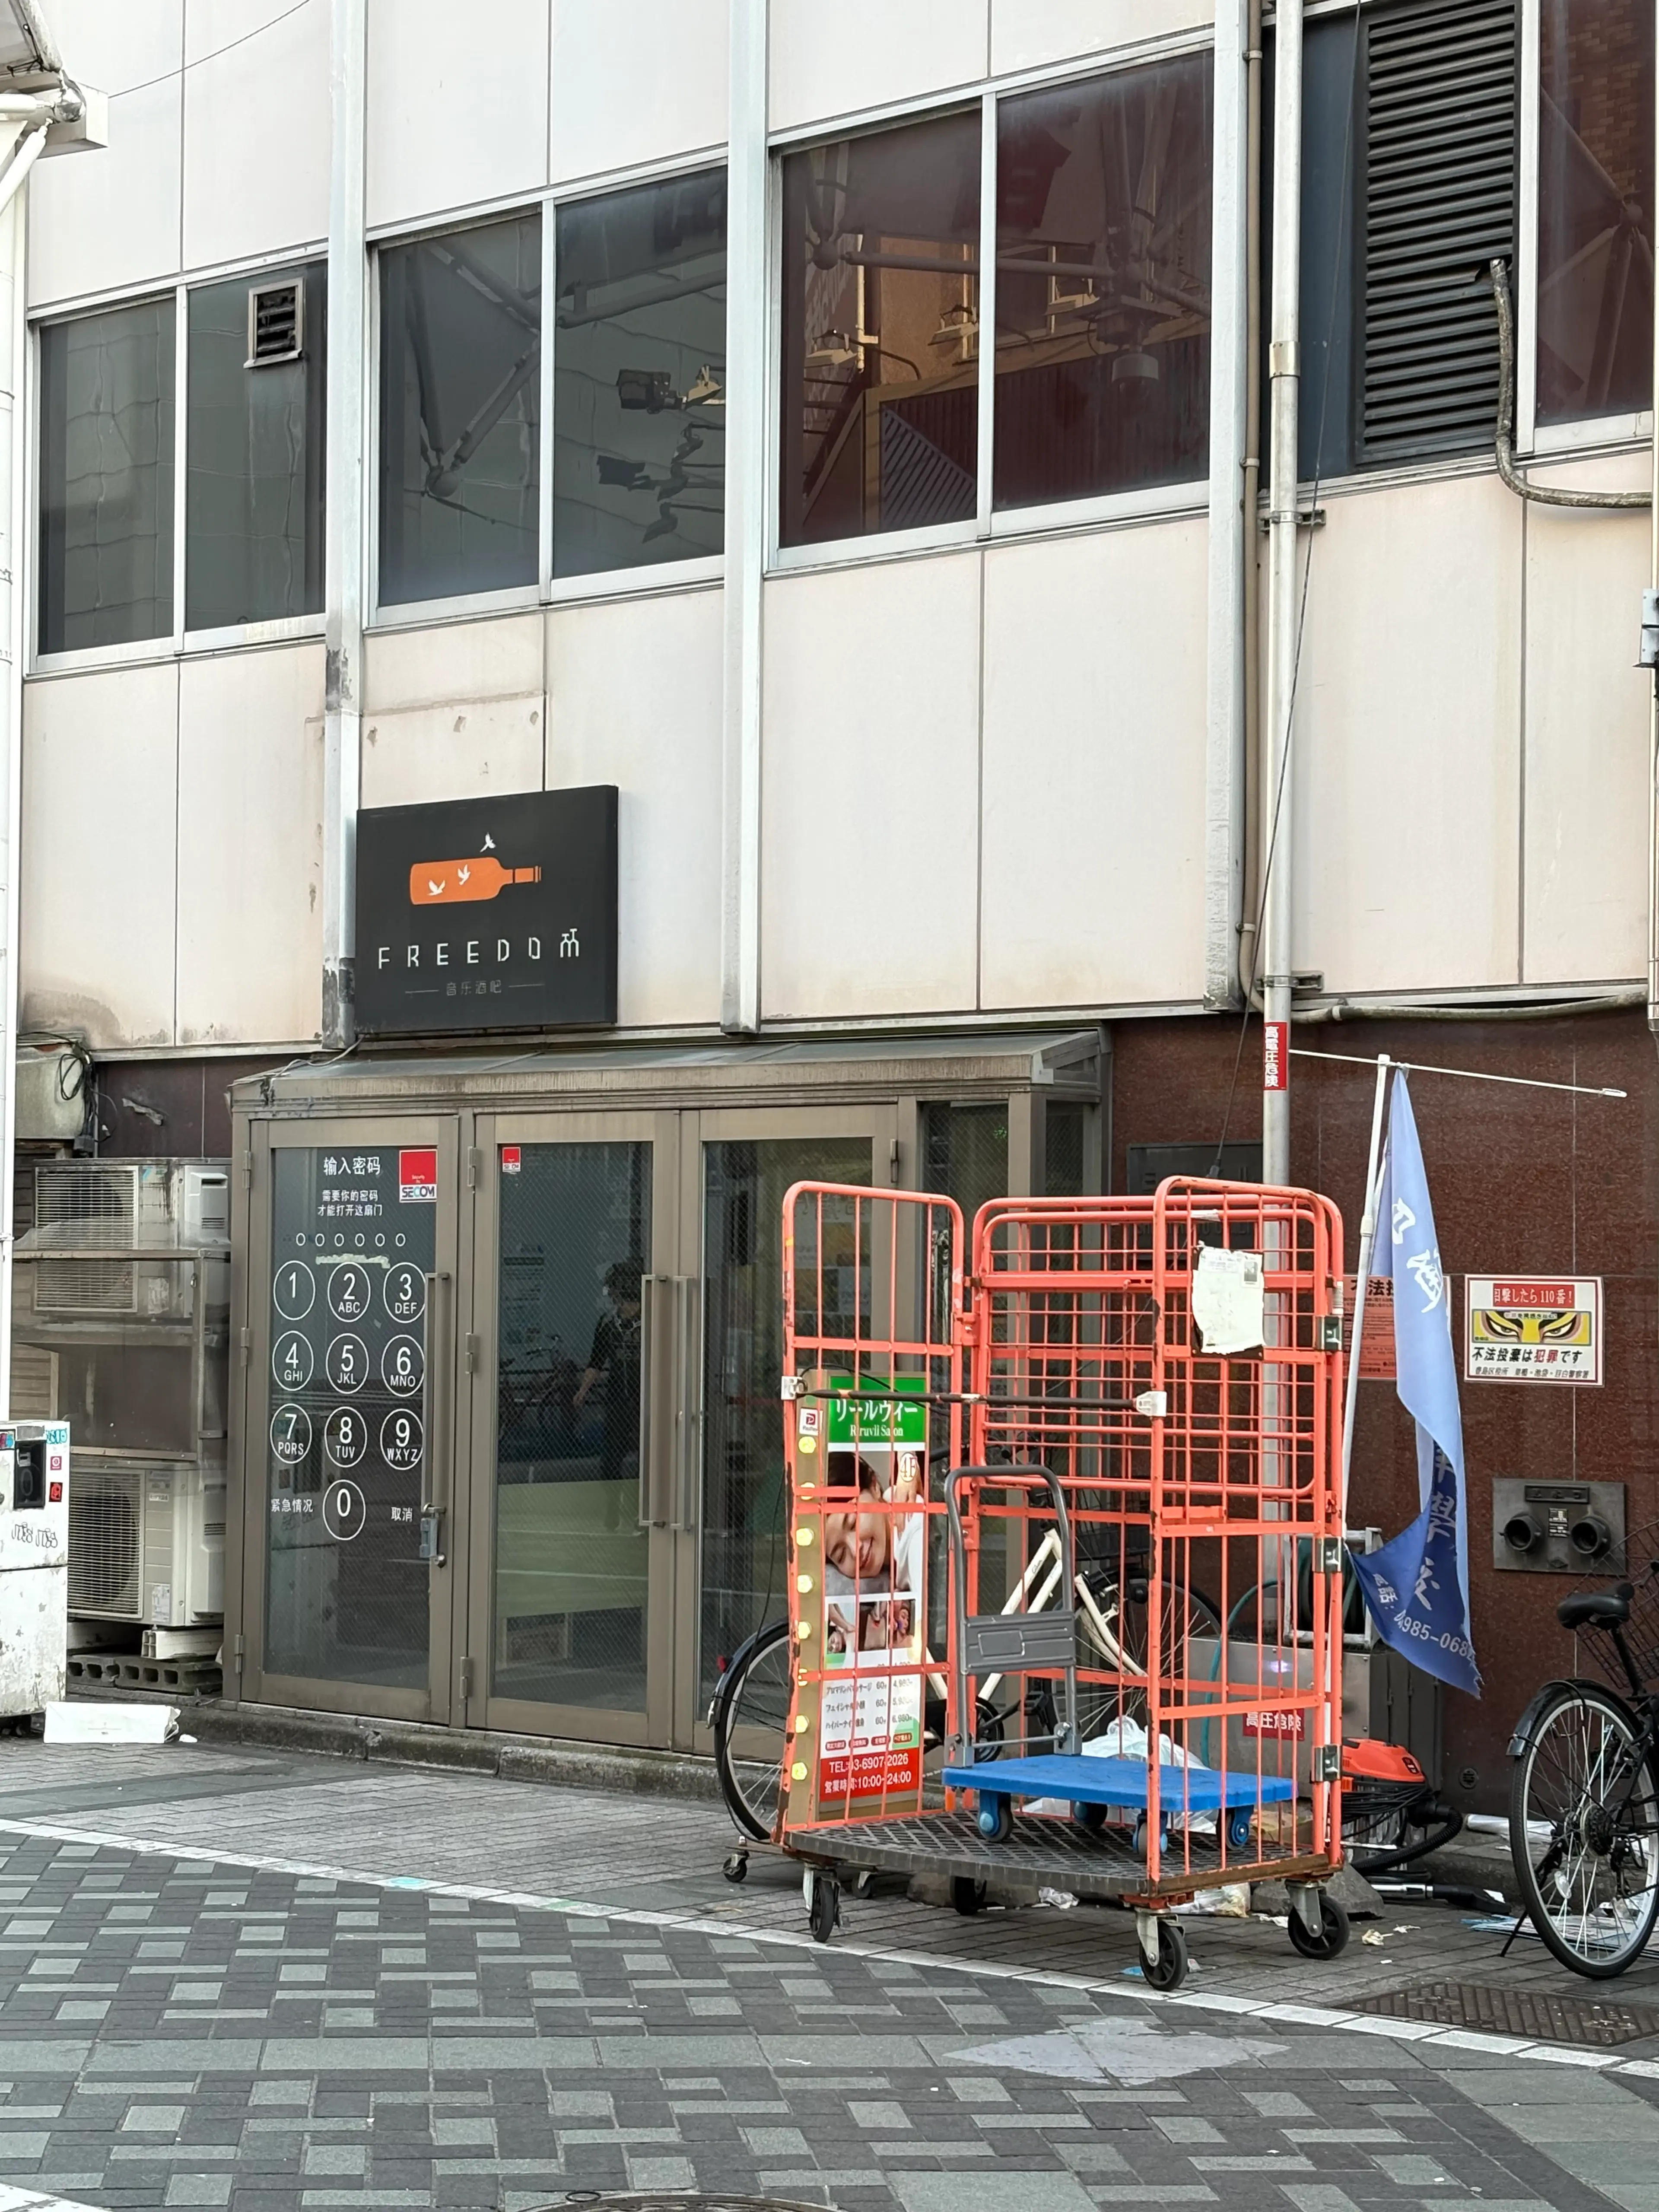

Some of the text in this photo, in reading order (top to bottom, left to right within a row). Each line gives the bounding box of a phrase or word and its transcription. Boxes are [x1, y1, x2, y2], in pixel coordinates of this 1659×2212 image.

[378, 928, 580, 969] FREEDOM
[446, 979, 502, 996] 音乐酒吧
[323, 1156, 381, 1176] 输入密码
[322, 1189, 378, 1202] 需要你的密码
[402, 1185, 435, 1198] SECOM
[317, 1203, 383, 1217] 才能打开这扇门
[289, 1271, 296, 1298] 1
[343, 1273, 356, 1300] 2
[399, 1274, 412, 1300] 3
[338, 1302, 360, 1314] ABC
[395, 1302, 417, 1314] DEF
[285, 1342, 299, 1369] 4
[341, 1344, 354, 1372] 5
[396, 1347, 411, 1375] 6
[1471, 1346, 1583, 1364] 不法投棄は犯罪です
[284, 1370, 303, 1382] GHI
[337, 1373, 357, 1385] JKL
[390, 1375, 416, 1387] MNO
[836, 1398, 918, 1422] リールウィー
[285, 1414, 297, 1440] 7
[339, 1416, 352, 1444] 8
[395, 1418, 410, 1448] 9
[881, 1424, 904, 1437] Saon
[278, 1442, 304, 1455] PQRS
[336, 1446, 355, 1459] TUV
[387, 1448, 418, 1462] WXYZ
[900, 1457, 917, 1478] 4F
[270, 1498, 313, 1513] 紧急情况
[337, 1488, 351, 1517] 0
[391, 1506, 413, 1522] 取消
